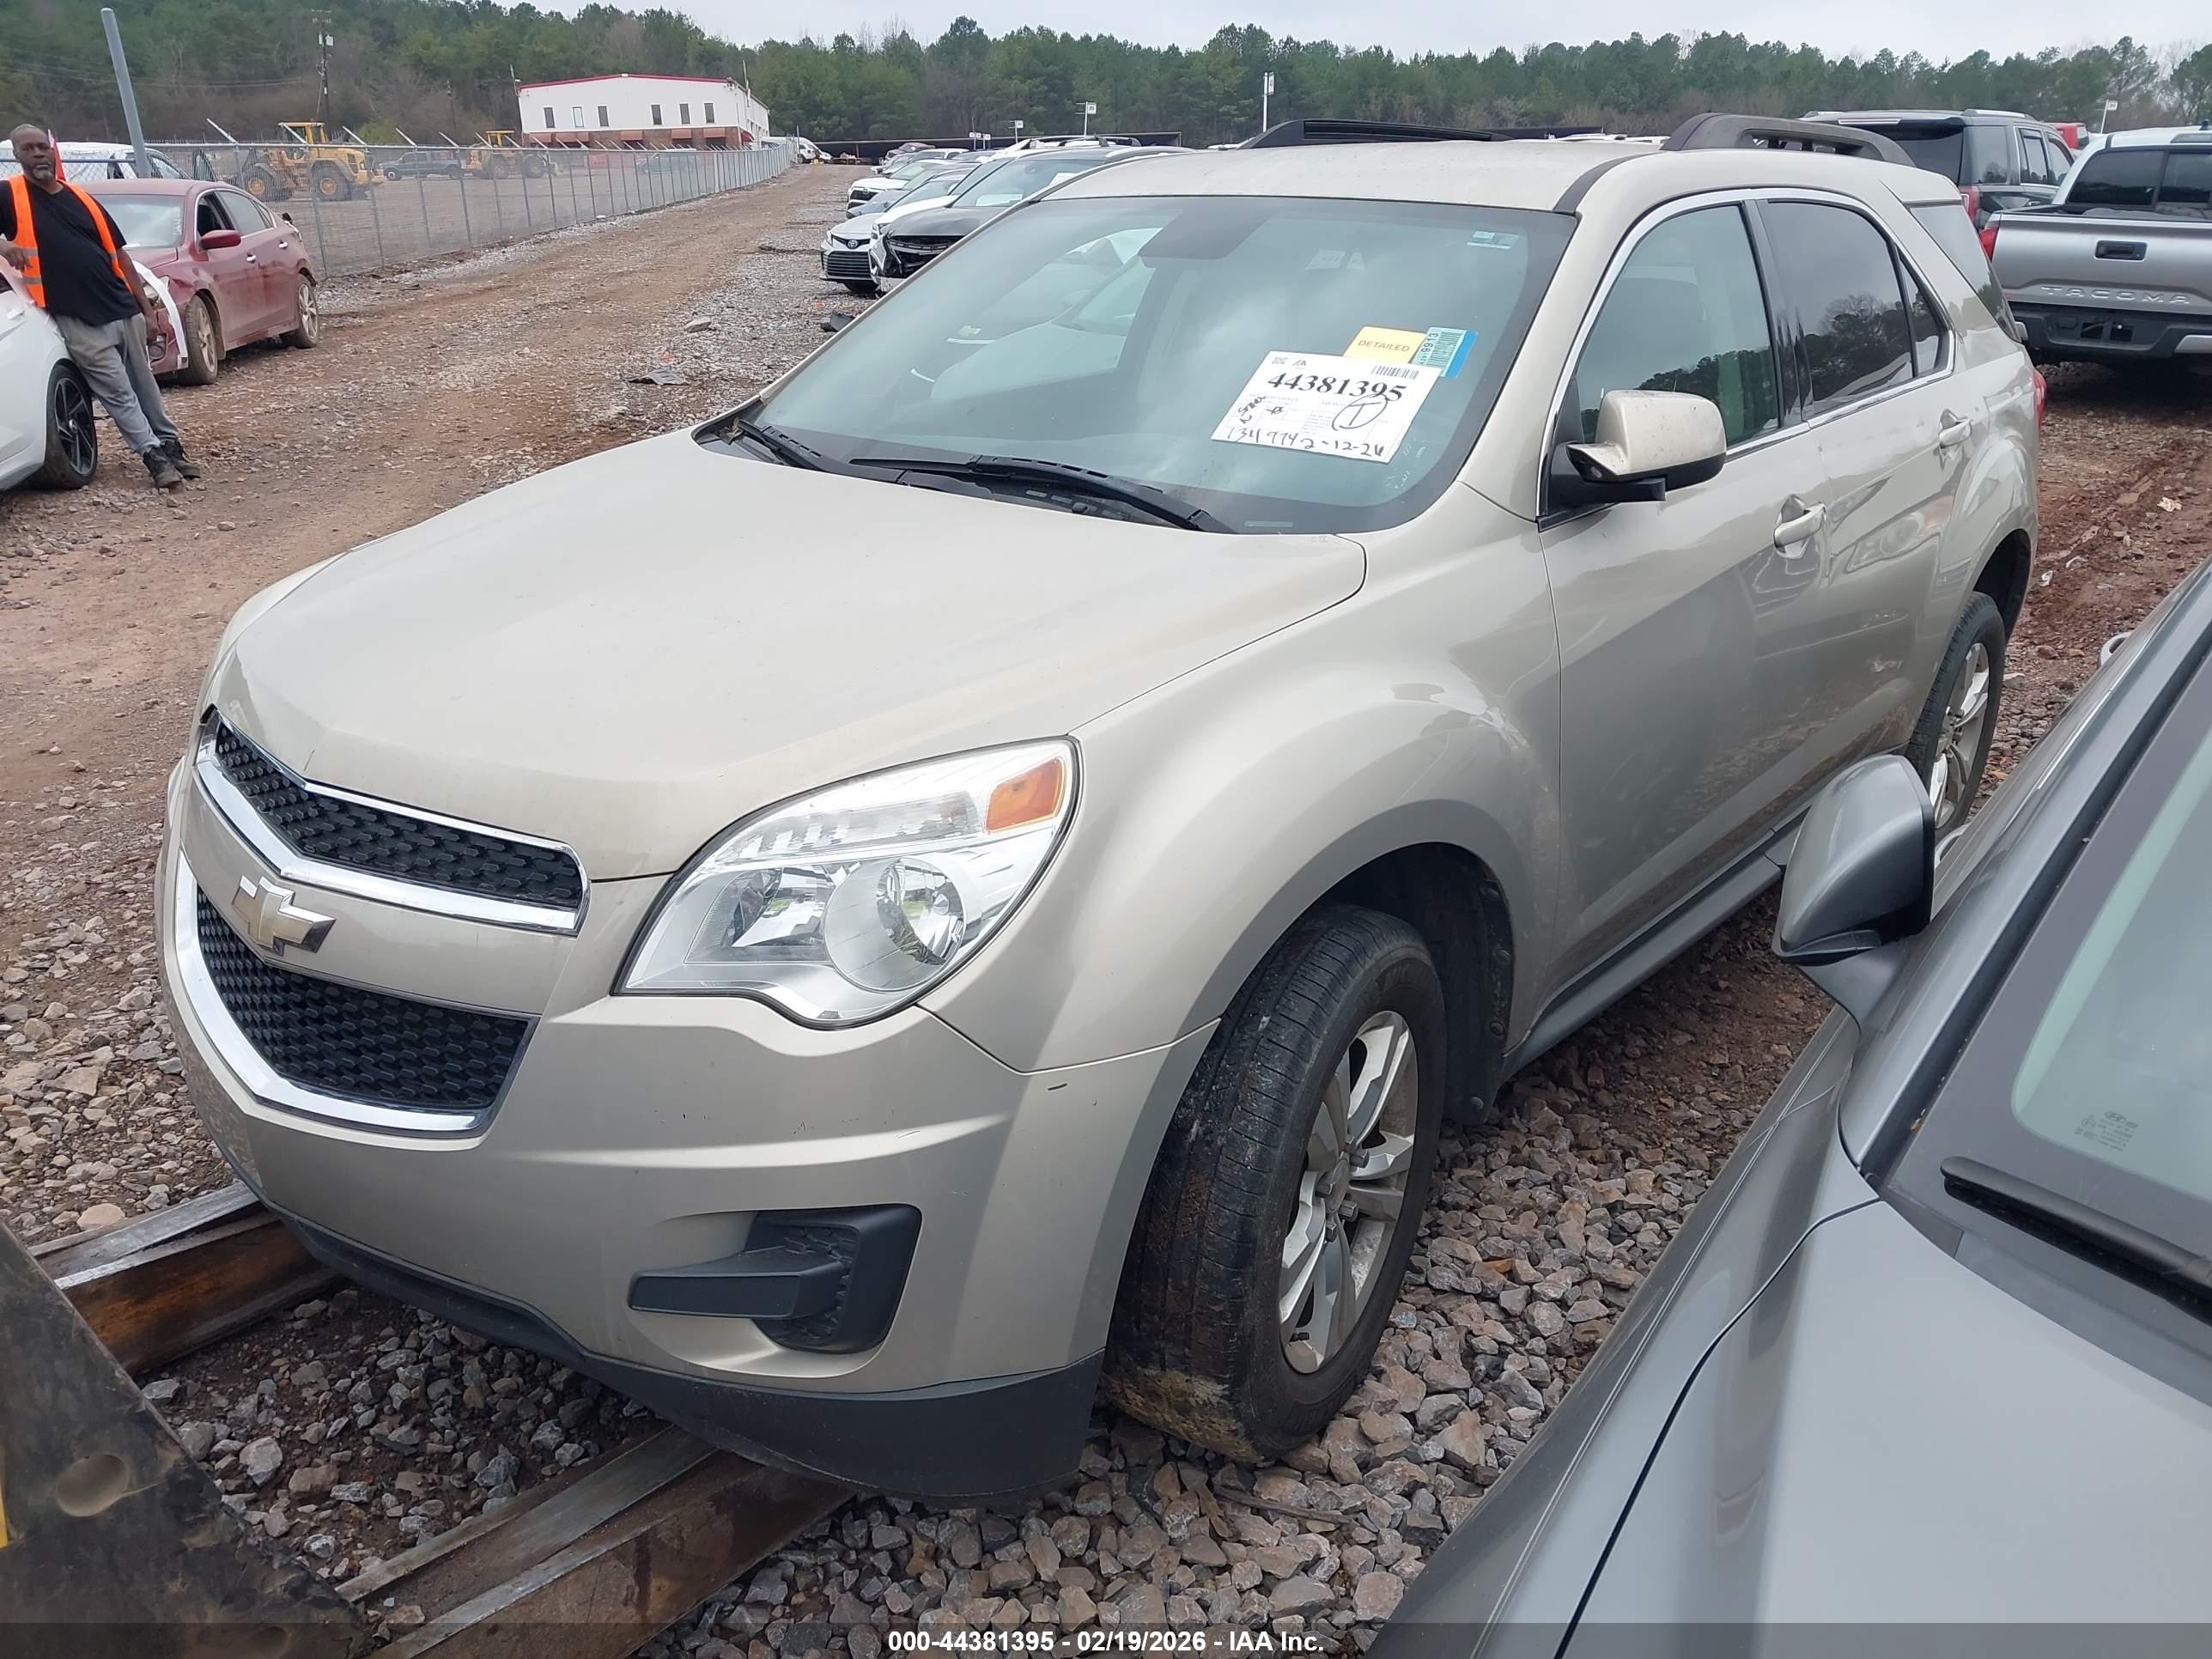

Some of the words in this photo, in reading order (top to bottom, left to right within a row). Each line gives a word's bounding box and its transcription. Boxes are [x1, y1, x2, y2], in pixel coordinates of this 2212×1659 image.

[2040, 286, 2191, 304] TACOMA
[1358, 339, 1411, 353] DETAILED
[1267, 372, 1407, 402] 44381395
